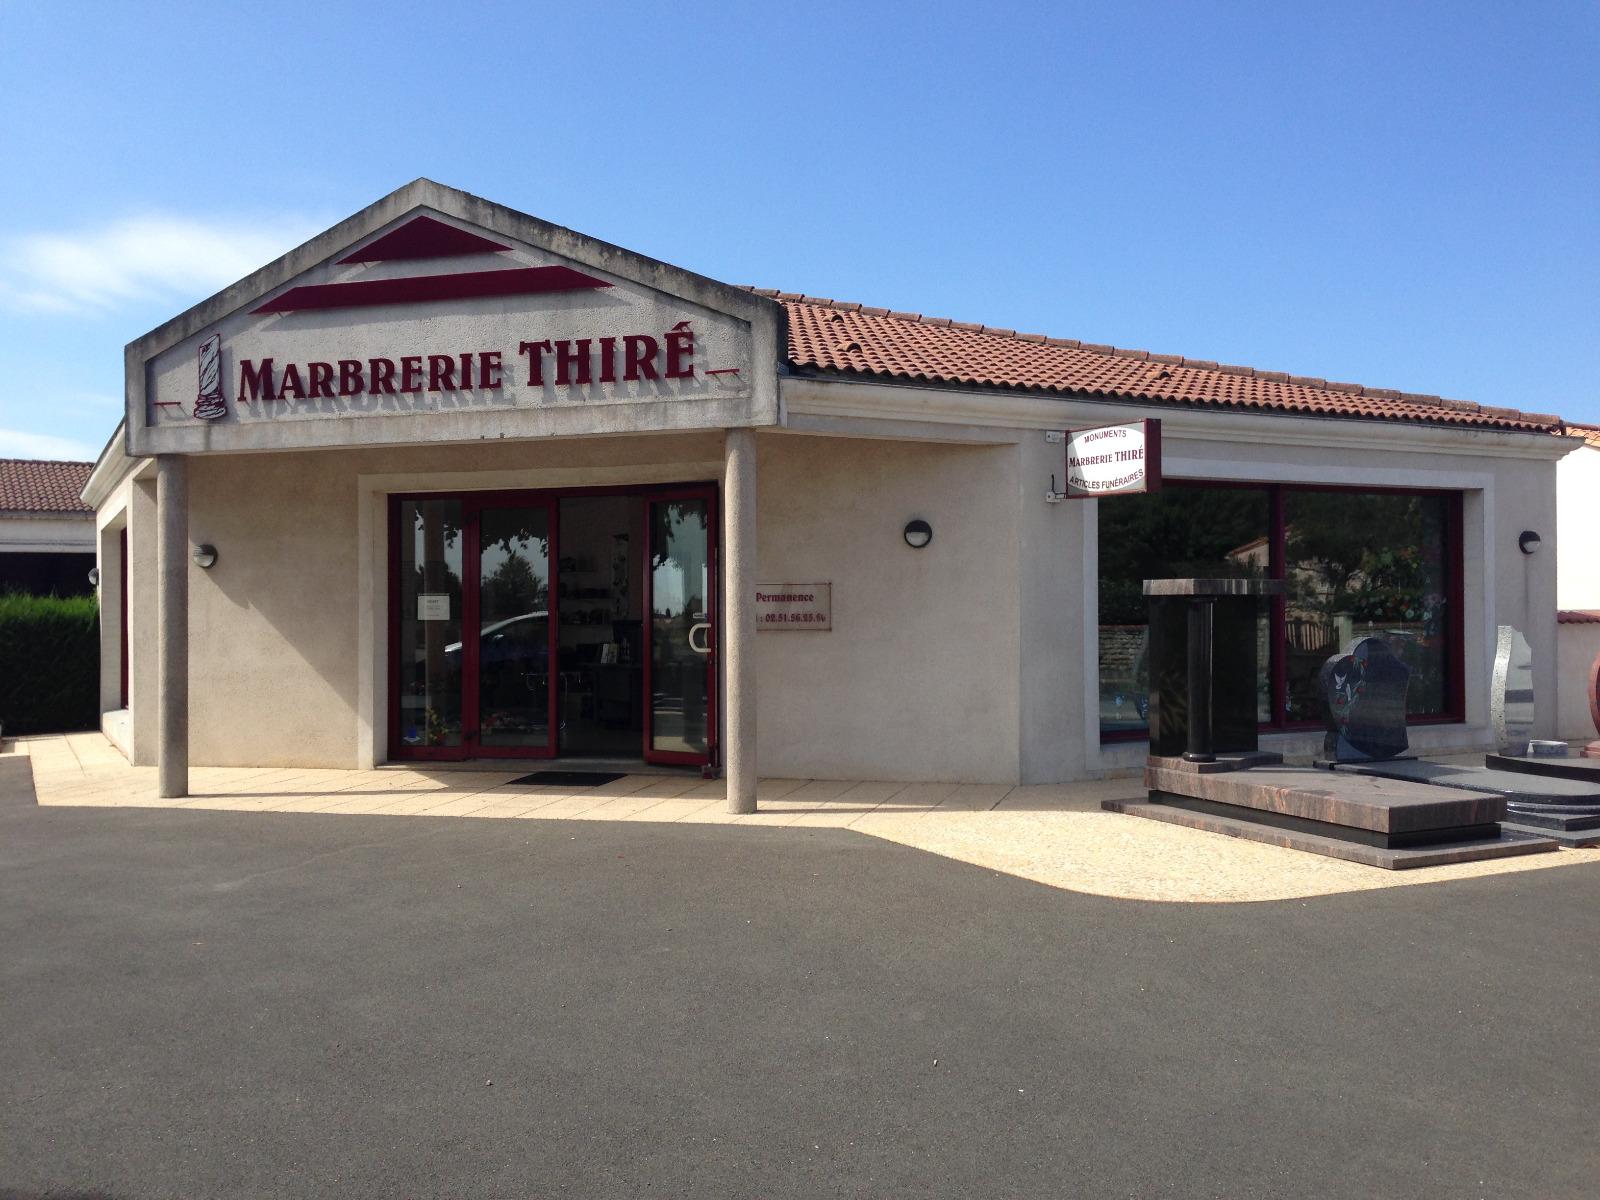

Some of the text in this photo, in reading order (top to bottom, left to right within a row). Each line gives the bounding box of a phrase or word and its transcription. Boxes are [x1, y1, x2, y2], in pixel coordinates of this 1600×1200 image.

[237, 321, 694, 402] MARBRERIE THIRÉ
[1084, 430, 1126, 443] MONUMENTS
[1069, 445, 1143, 467] MARBRERIE THIRÉ
[1069, 468, 1143, 489] ARTICLES FUNÉRAIRES
[757, 592, 814, 604] Permanence
